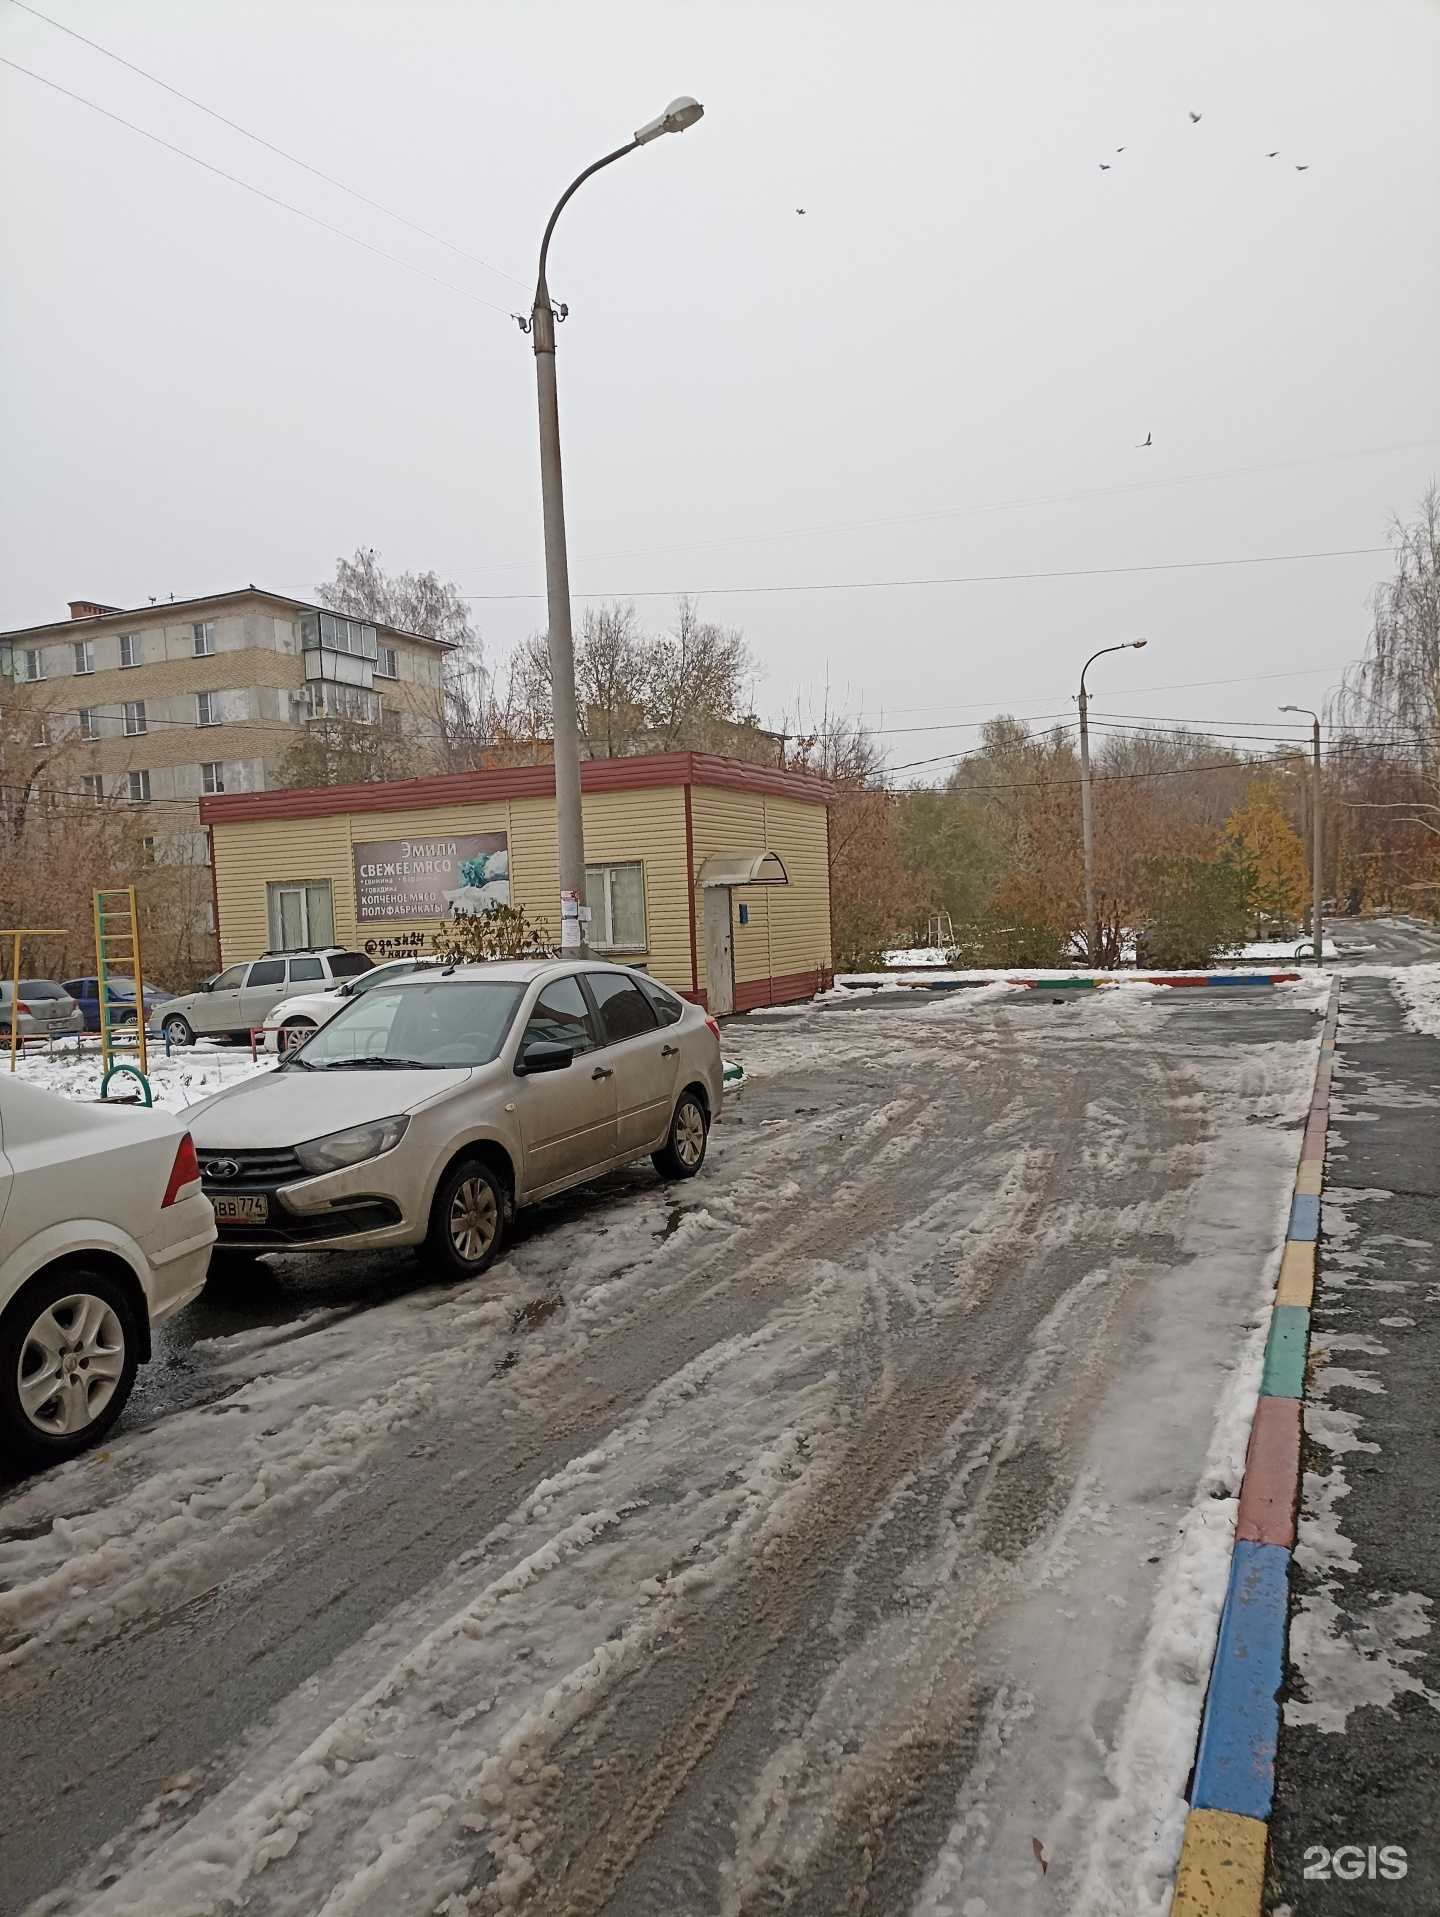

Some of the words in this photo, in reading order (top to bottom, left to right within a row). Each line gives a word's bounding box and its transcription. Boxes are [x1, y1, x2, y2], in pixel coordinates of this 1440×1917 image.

[401, 841, 457, 858] Эмили
[360, 861, 410, 877] СВЕЖЕЕ
[413, 859, 451, 873] МЯСО
[362, 904, 443, 916] ПОЛУФАБРИКАТЫ
